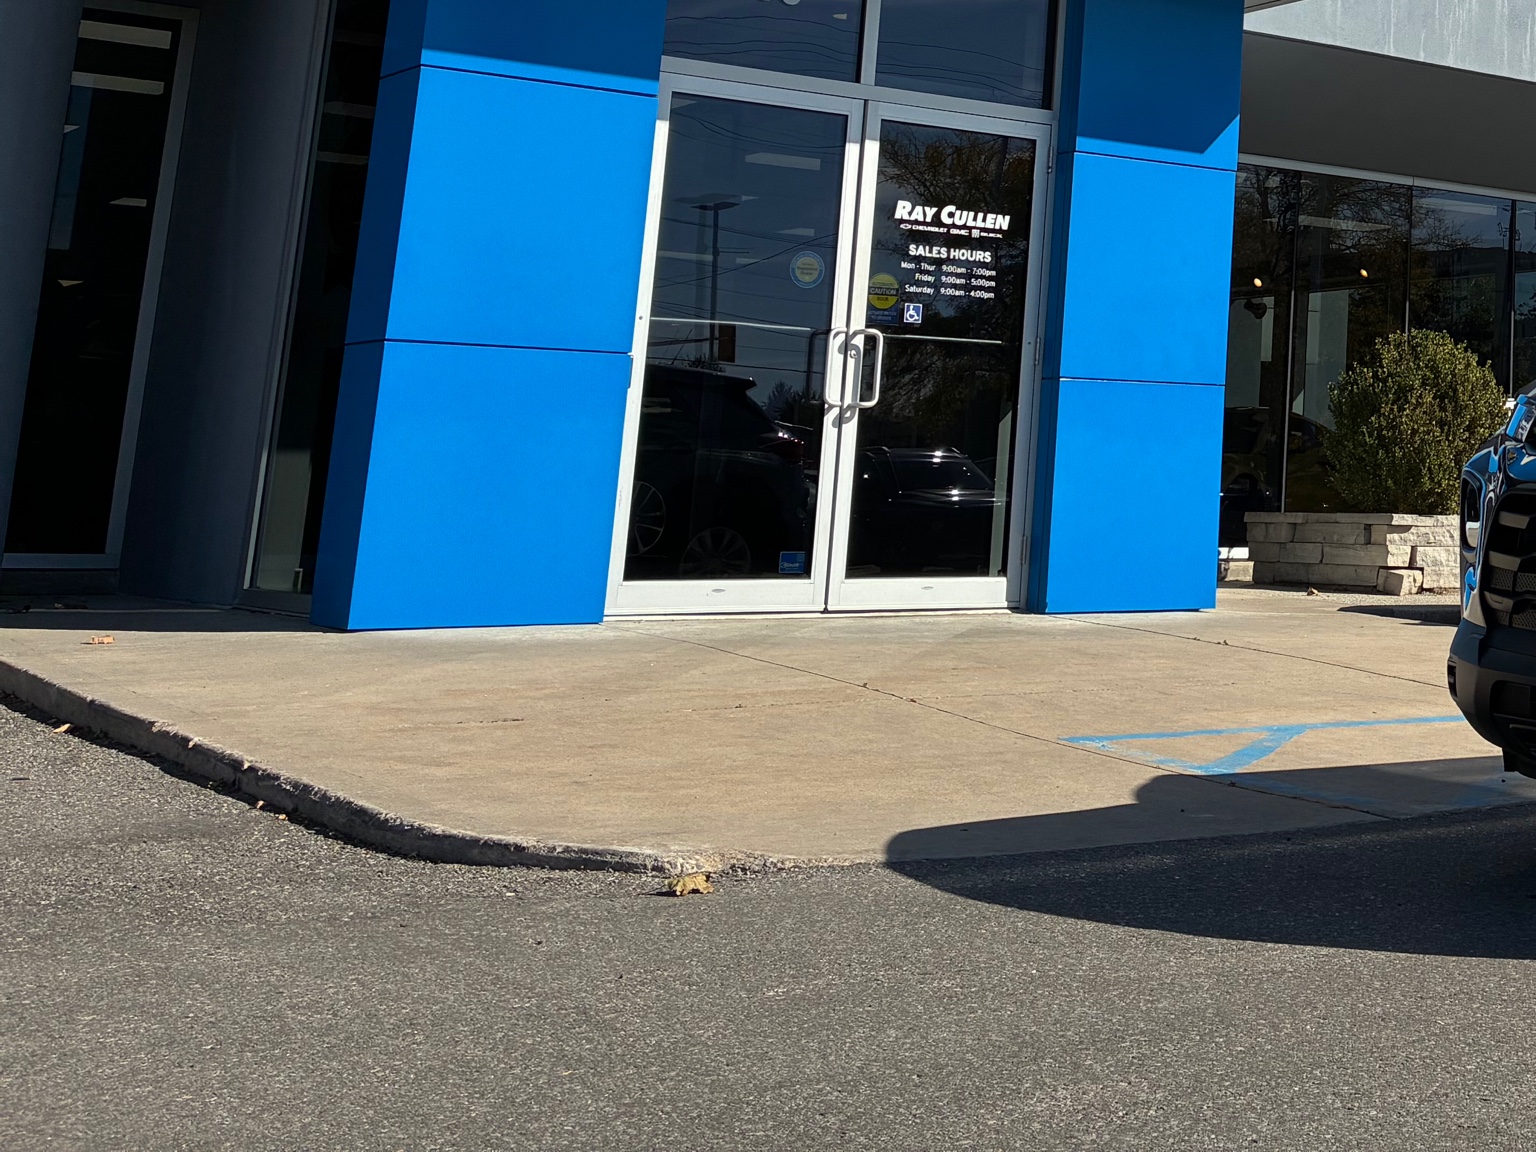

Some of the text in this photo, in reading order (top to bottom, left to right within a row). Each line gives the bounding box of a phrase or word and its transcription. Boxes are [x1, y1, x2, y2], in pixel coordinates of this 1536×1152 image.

[894, 200, 1011, 230] RAY CULLEN
[912, 224, 948, 233] CHEVROLET
[949, 228, 970, 236] GMC
[908, 244, 992, 263] SALES HOURS
[901, 261, 915, 270] Mon
[920, 262, 936, 271] Thur
[941, 264, 967, 274] 9:00am
[972, 267, 996, 277] 7:00pm
[915, 273, 935, 283] Friday
[940, 275, 965, 285] 9:00am
[970, 278, 996, 288] 5:00pm
[870, 287, 897, 295] CAUTION
[904, 284, 934, 295] Saturday
[940, 287, 965, 297] 9:00am
[970, 289, 995, 299] 4:00pm
